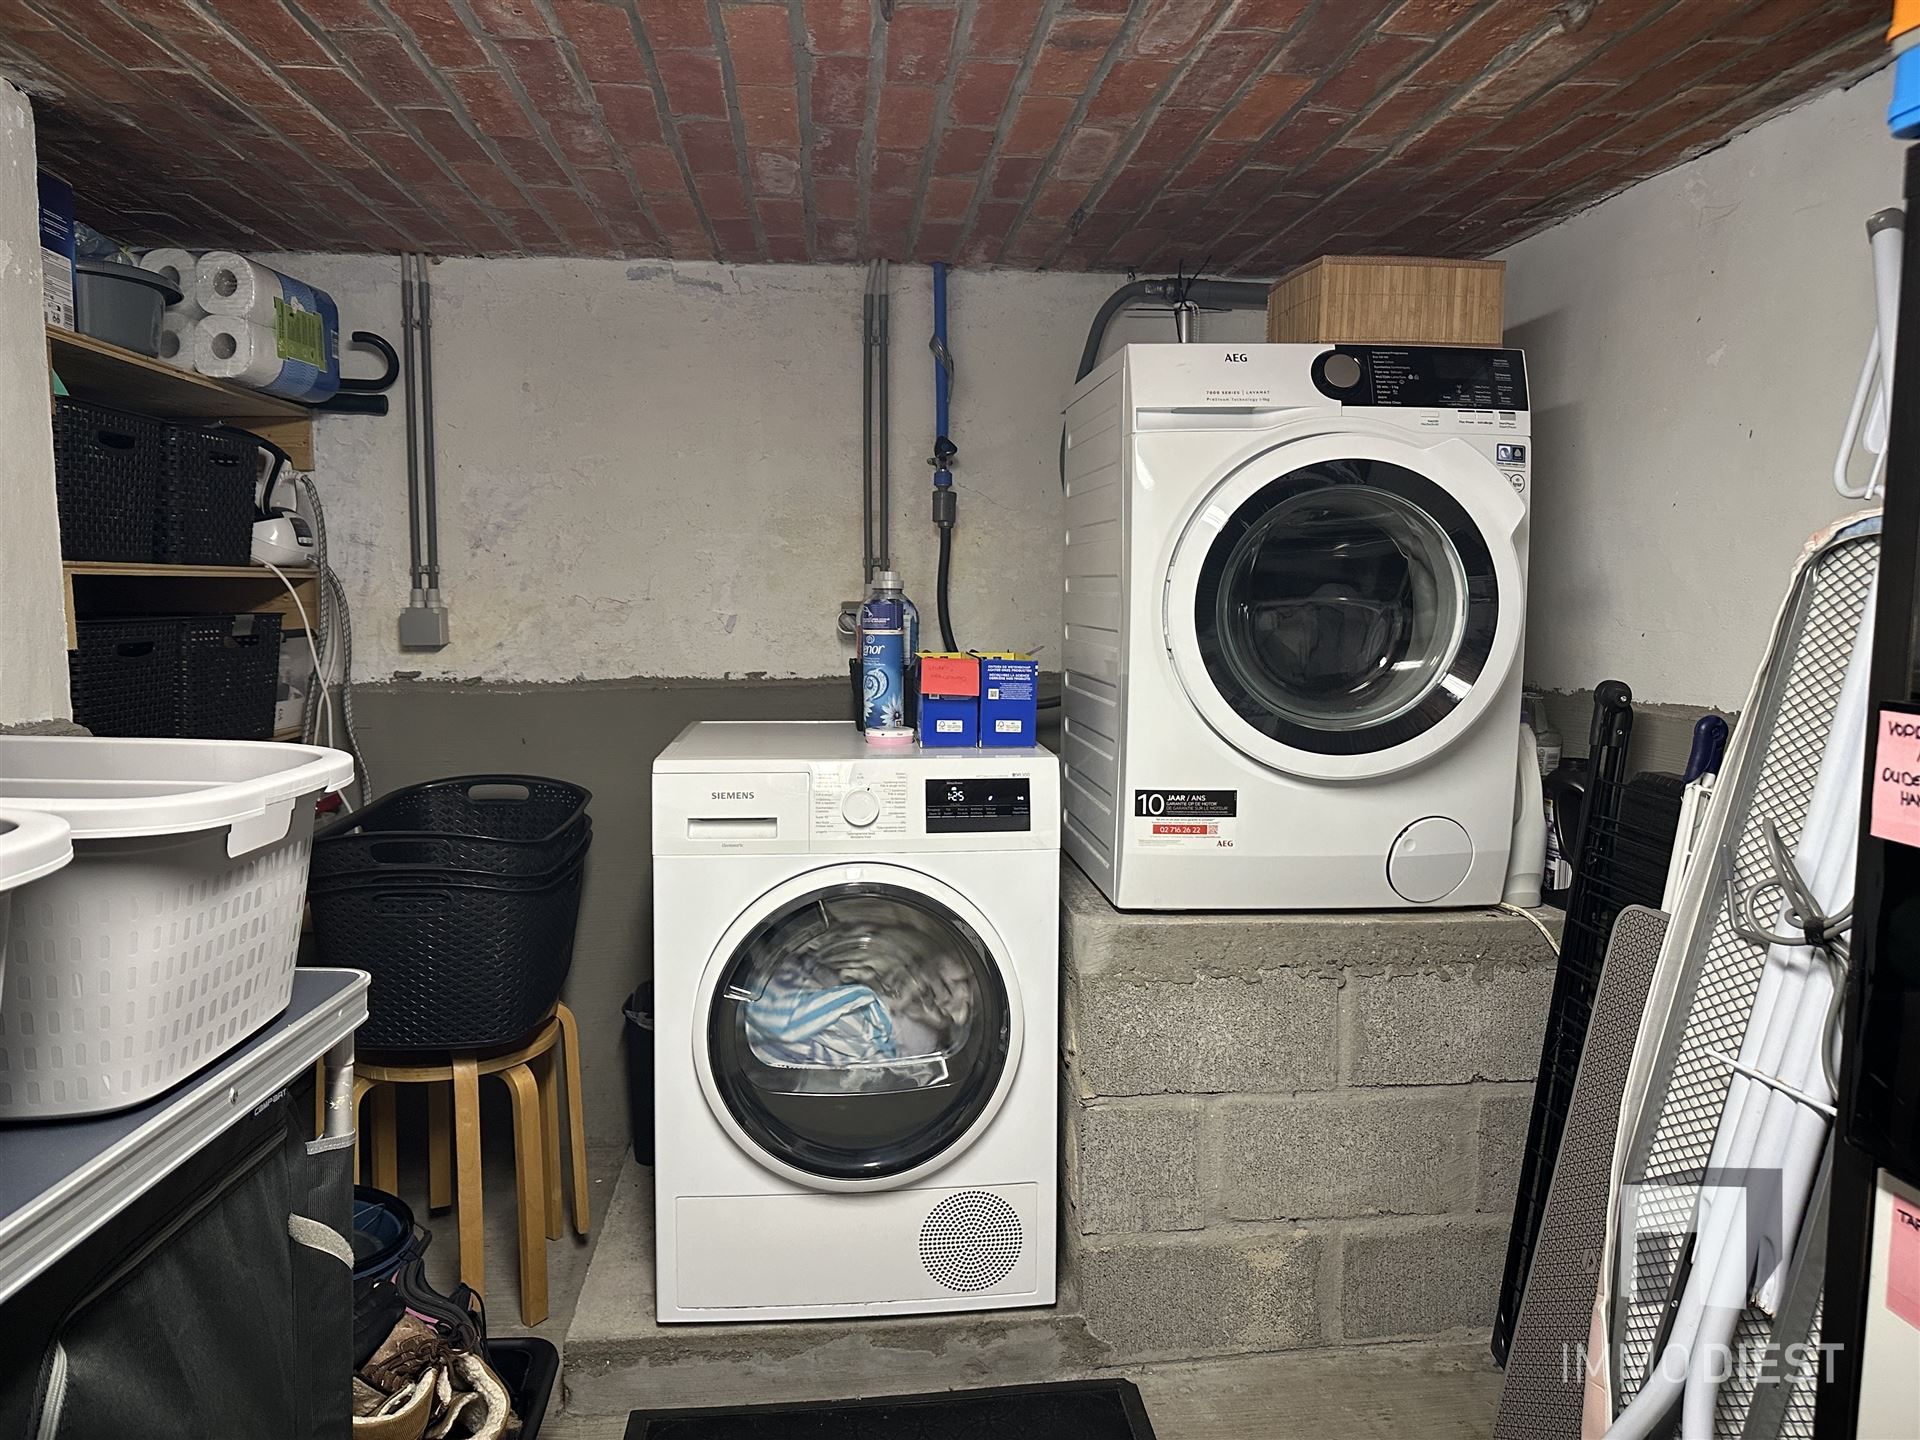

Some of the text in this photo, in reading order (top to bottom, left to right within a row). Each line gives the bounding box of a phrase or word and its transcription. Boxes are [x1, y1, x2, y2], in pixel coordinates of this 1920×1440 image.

[1224, 353, 1248, 362] AEG
[711, 791, 755, 800] SIEMENS
[1166, 794, 1186, 802] JAAR
[1191, 794, 1206, 802] ANS
[1137, 793, 1165, 815] 10
